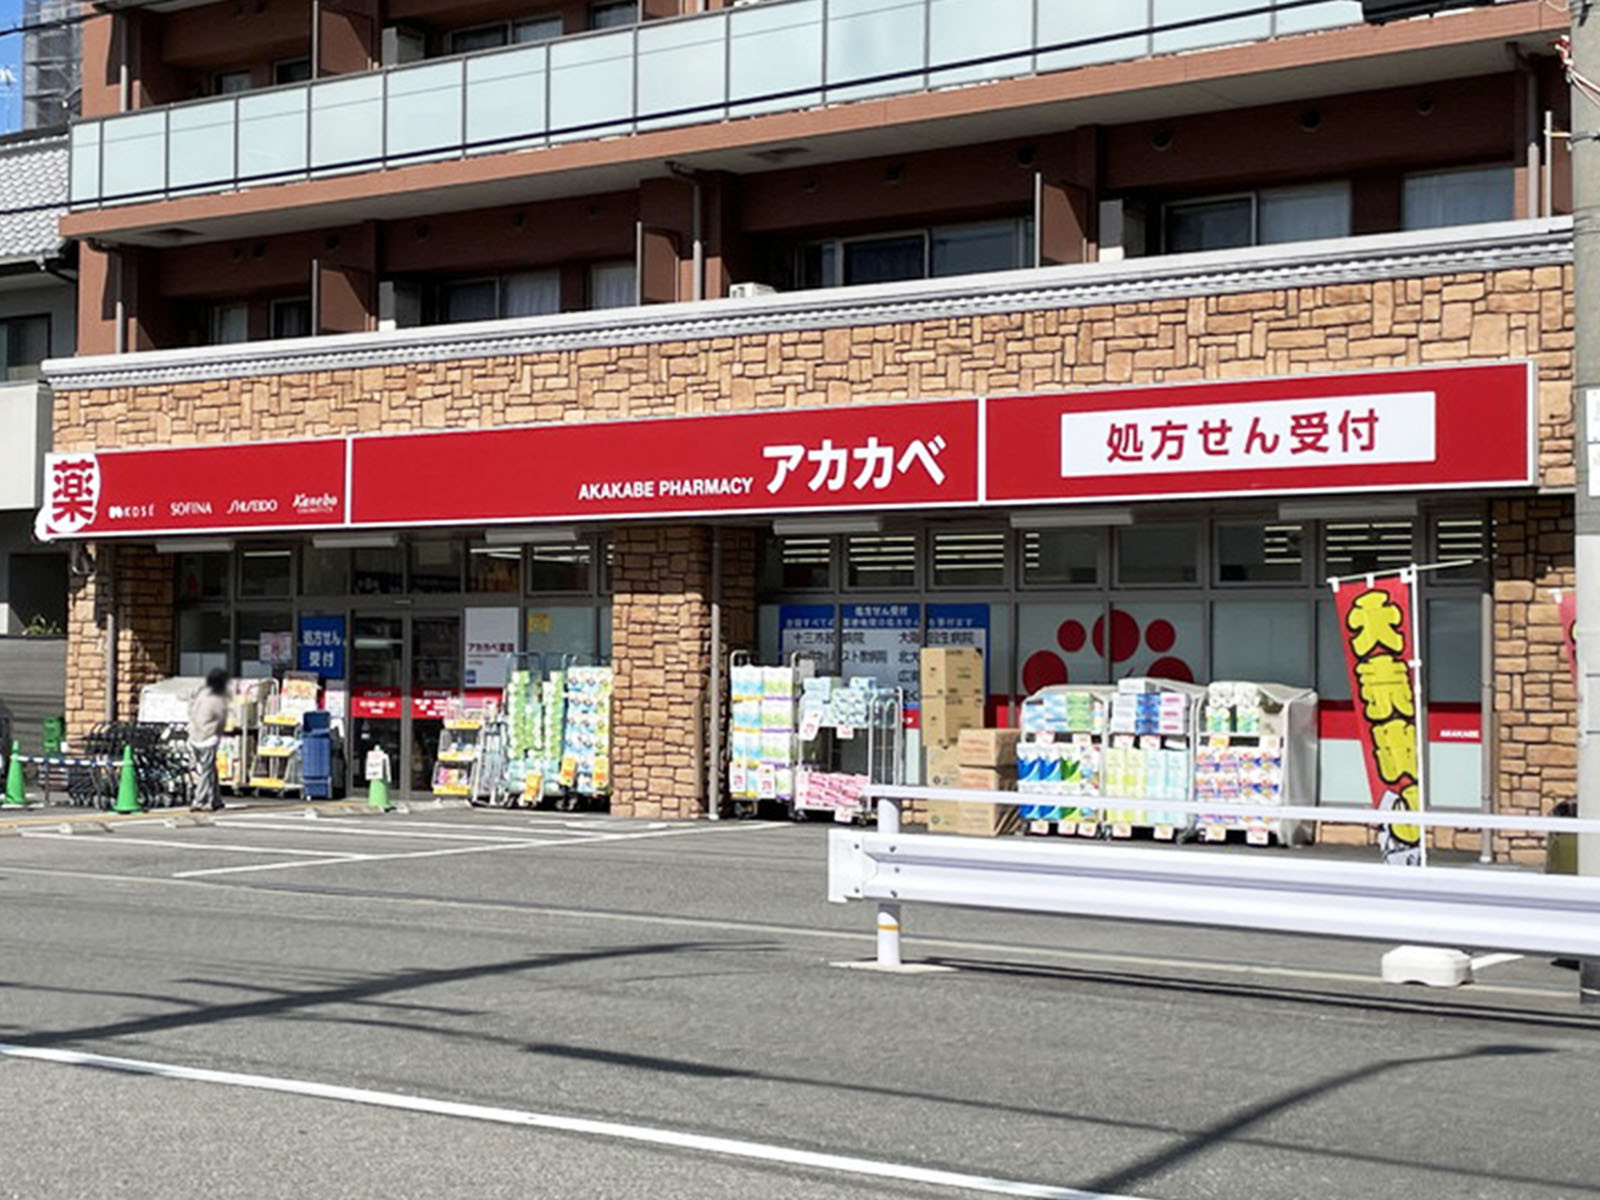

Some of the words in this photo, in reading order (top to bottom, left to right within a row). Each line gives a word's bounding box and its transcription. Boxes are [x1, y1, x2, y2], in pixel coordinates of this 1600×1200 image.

[1106, 408, 1379, 463] 処方せん受付
[763, 434, 947, 494] アカカベ
[52, 459, 95, 523] 薬
[578, 481, 655, 501] AKAKABE
[658, 477, 754, 497] PHARMACY
[170, 501, 213, 516] SOFINA
[303, 630, 341, 646] 処方せん
[309, 650, 335, 668] 受付
